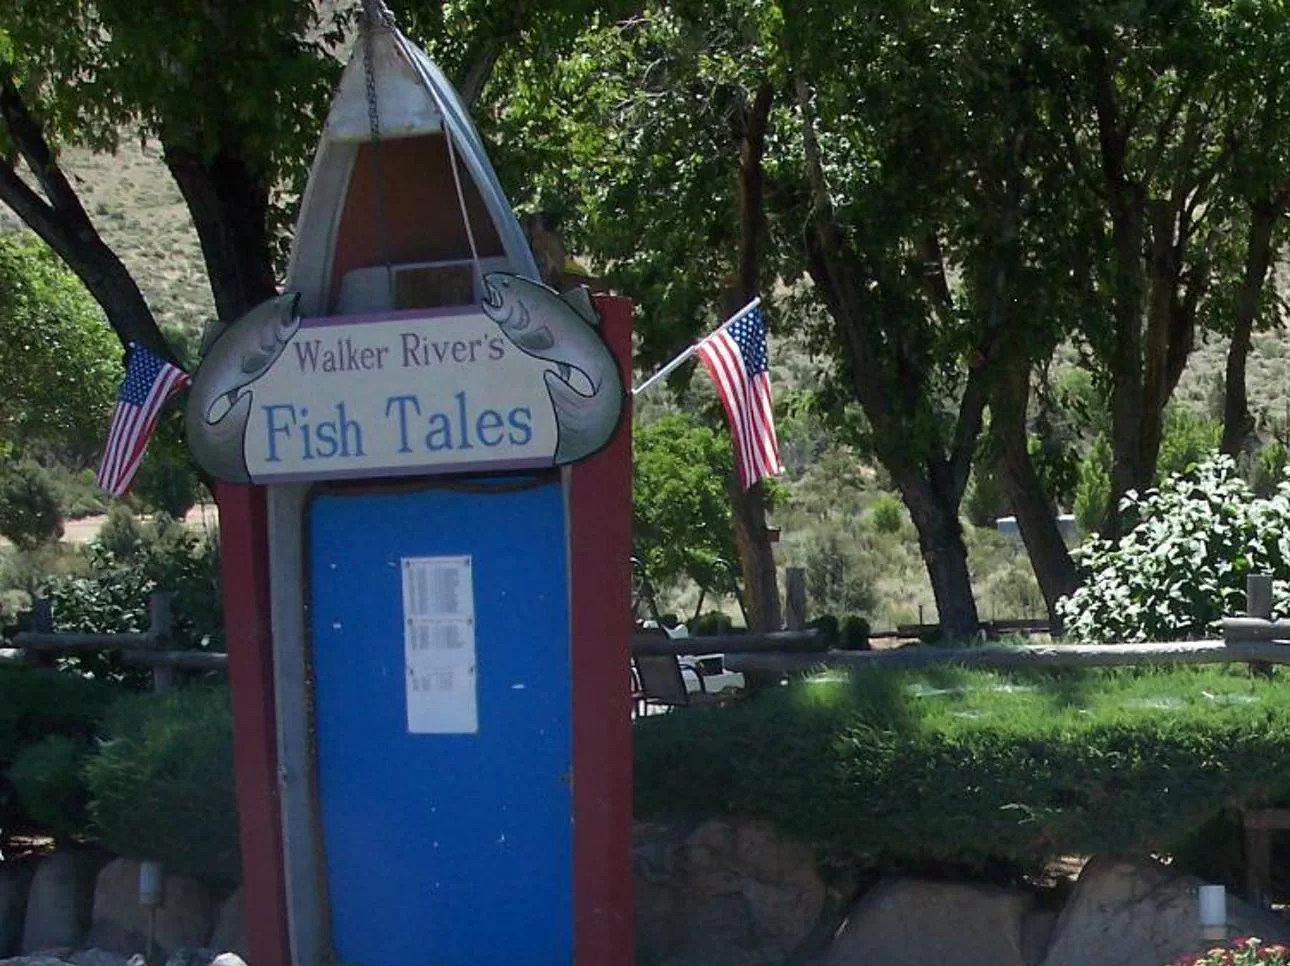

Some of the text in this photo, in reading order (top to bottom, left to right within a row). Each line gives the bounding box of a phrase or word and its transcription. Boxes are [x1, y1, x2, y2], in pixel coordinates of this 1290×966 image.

[294, 332, 505, 373] Walker River's
[261, 391, 532, 462] Fish Tales
